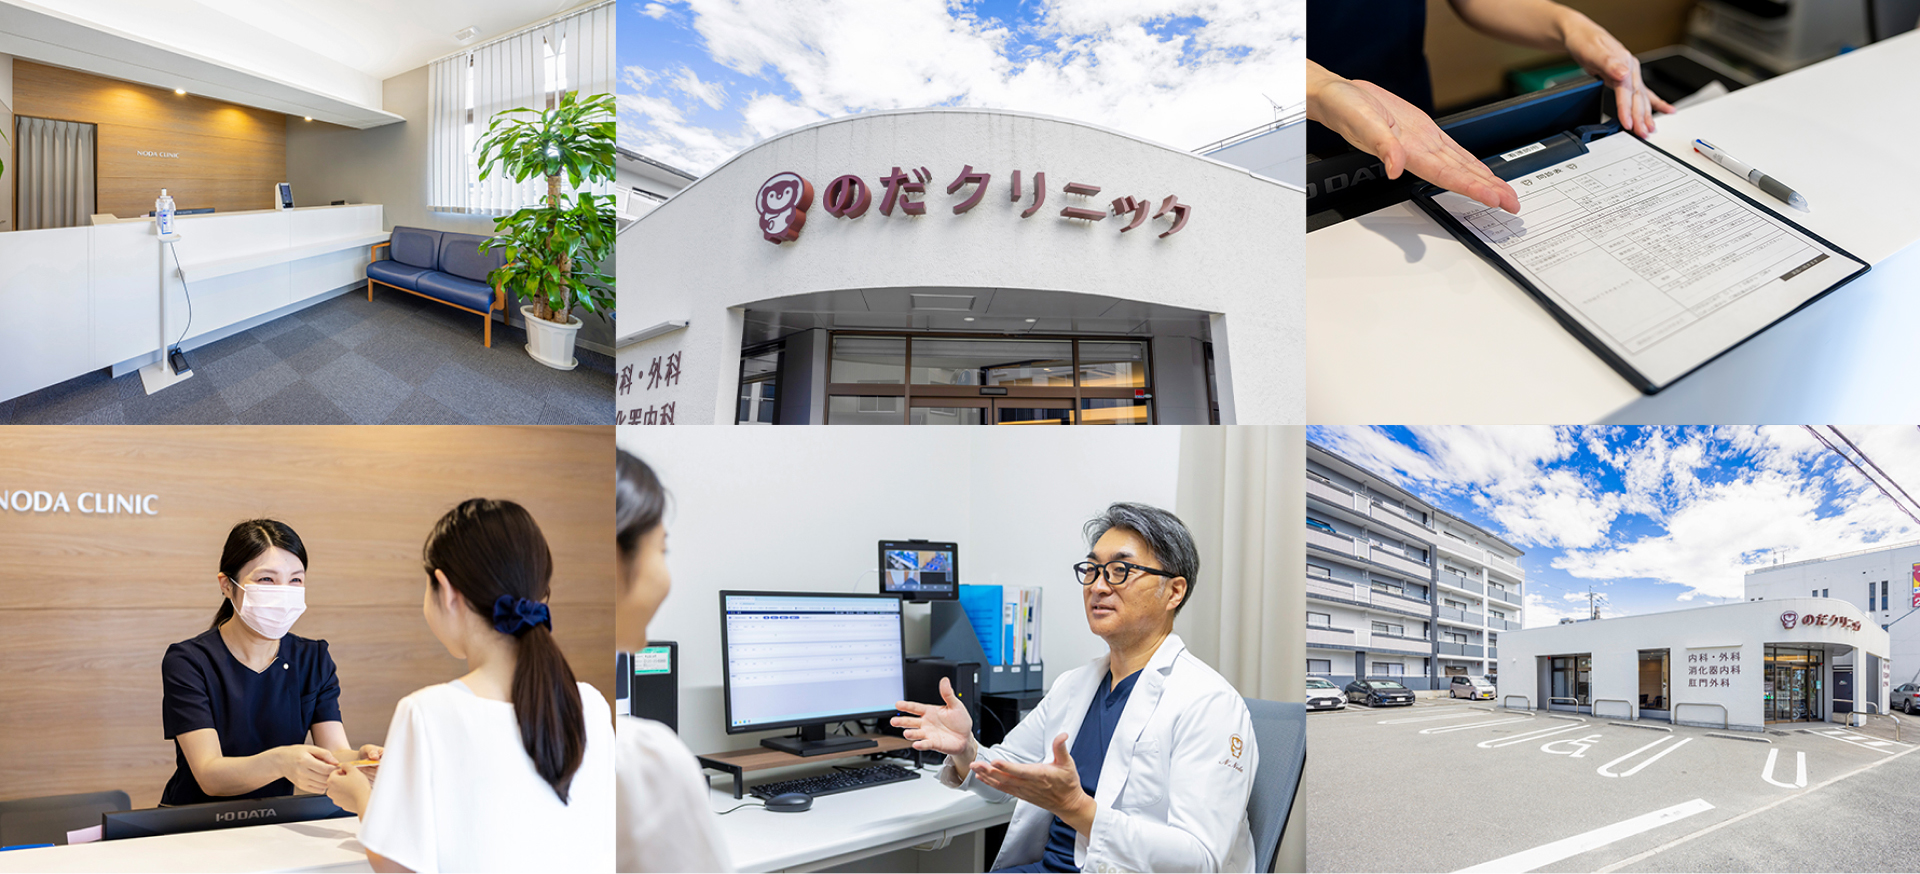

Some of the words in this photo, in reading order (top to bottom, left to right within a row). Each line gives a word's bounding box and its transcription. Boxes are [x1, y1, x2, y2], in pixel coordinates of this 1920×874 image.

[823, 164, 1192, 239] のだクリニック
[616, 350, 682, 396] 科・外科
[77, 491, 159, 515] CLINIC
[1688, 651, 1741, 663] 内科・外科
[1688, 664, 1741, 675] 消化器内科
[1688, 678, 1730, 688] 肛門外科
[237, 808, 278, 820] DATA
